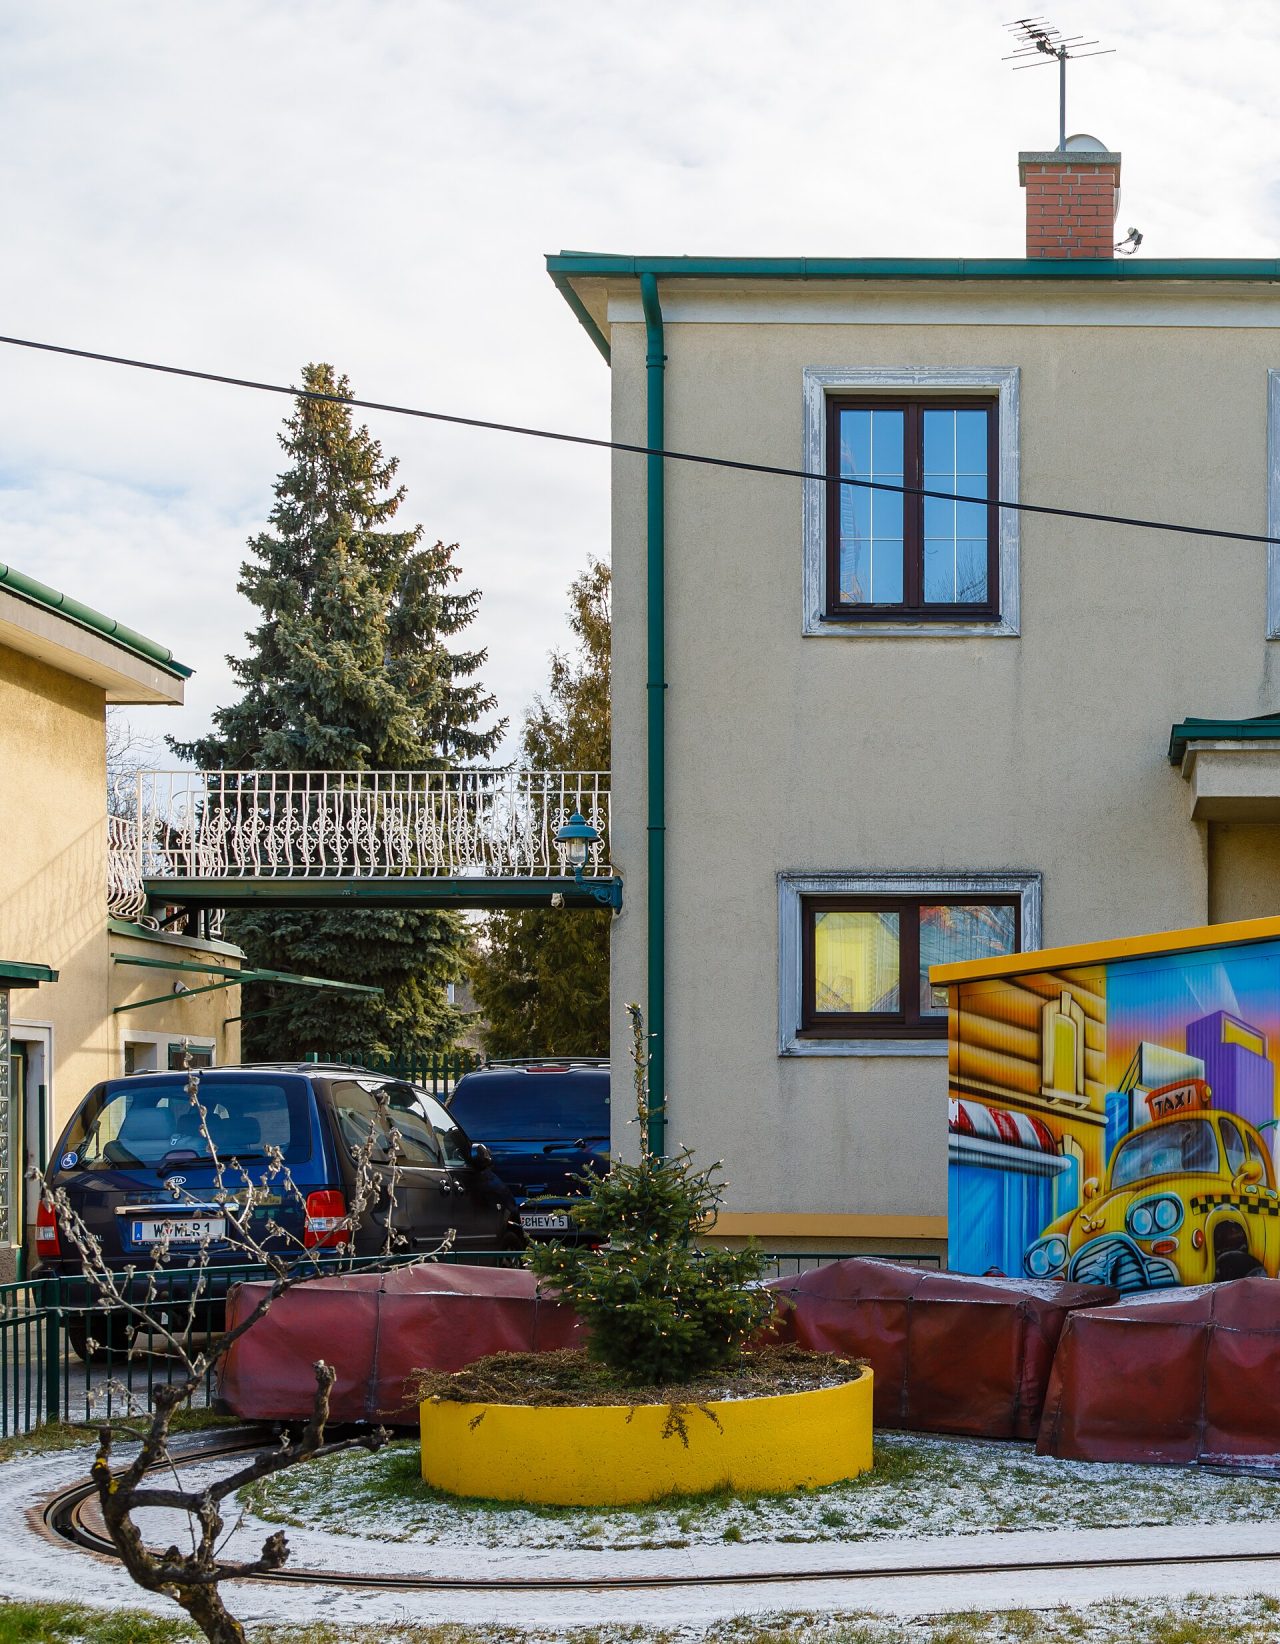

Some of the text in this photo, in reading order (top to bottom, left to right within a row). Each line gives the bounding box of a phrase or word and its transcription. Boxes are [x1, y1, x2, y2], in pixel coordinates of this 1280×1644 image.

[1154, 1089, 1192, 1117] TAXI
[525, 1216, 565, 1227] CHEVY 5
[153, 1223, 163, 1238] W
